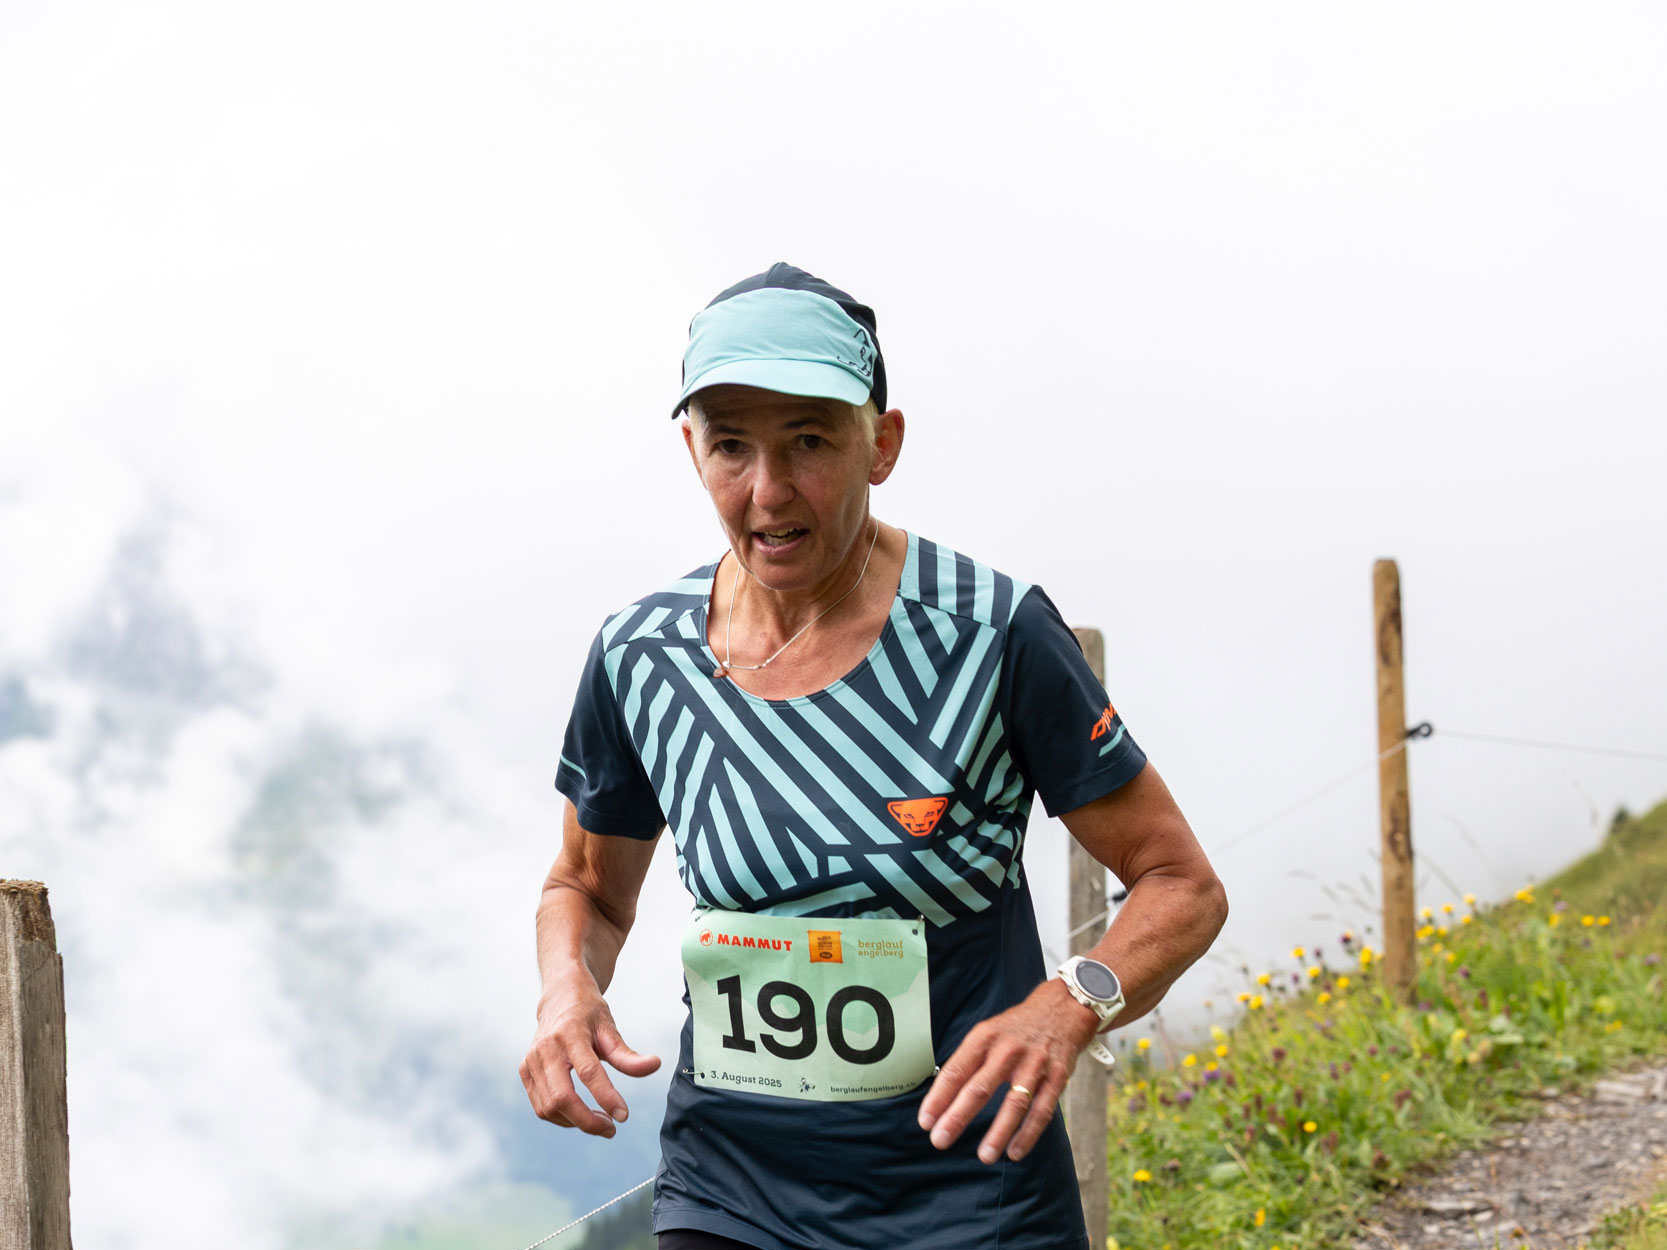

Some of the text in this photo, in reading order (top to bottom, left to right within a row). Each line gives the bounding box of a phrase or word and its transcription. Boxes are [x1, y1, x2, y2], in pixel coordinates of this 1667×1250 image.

[1090, 702, 1117, 741] DYN
[717, 933, 793, 952] MAMMUT
[858, 940, 904, 951] berglauf
[858, 949, 905, 959] engelberg
[716, 974, 896, 1065] 190
[710, 1070, 783, 1089] 3. August 2025
